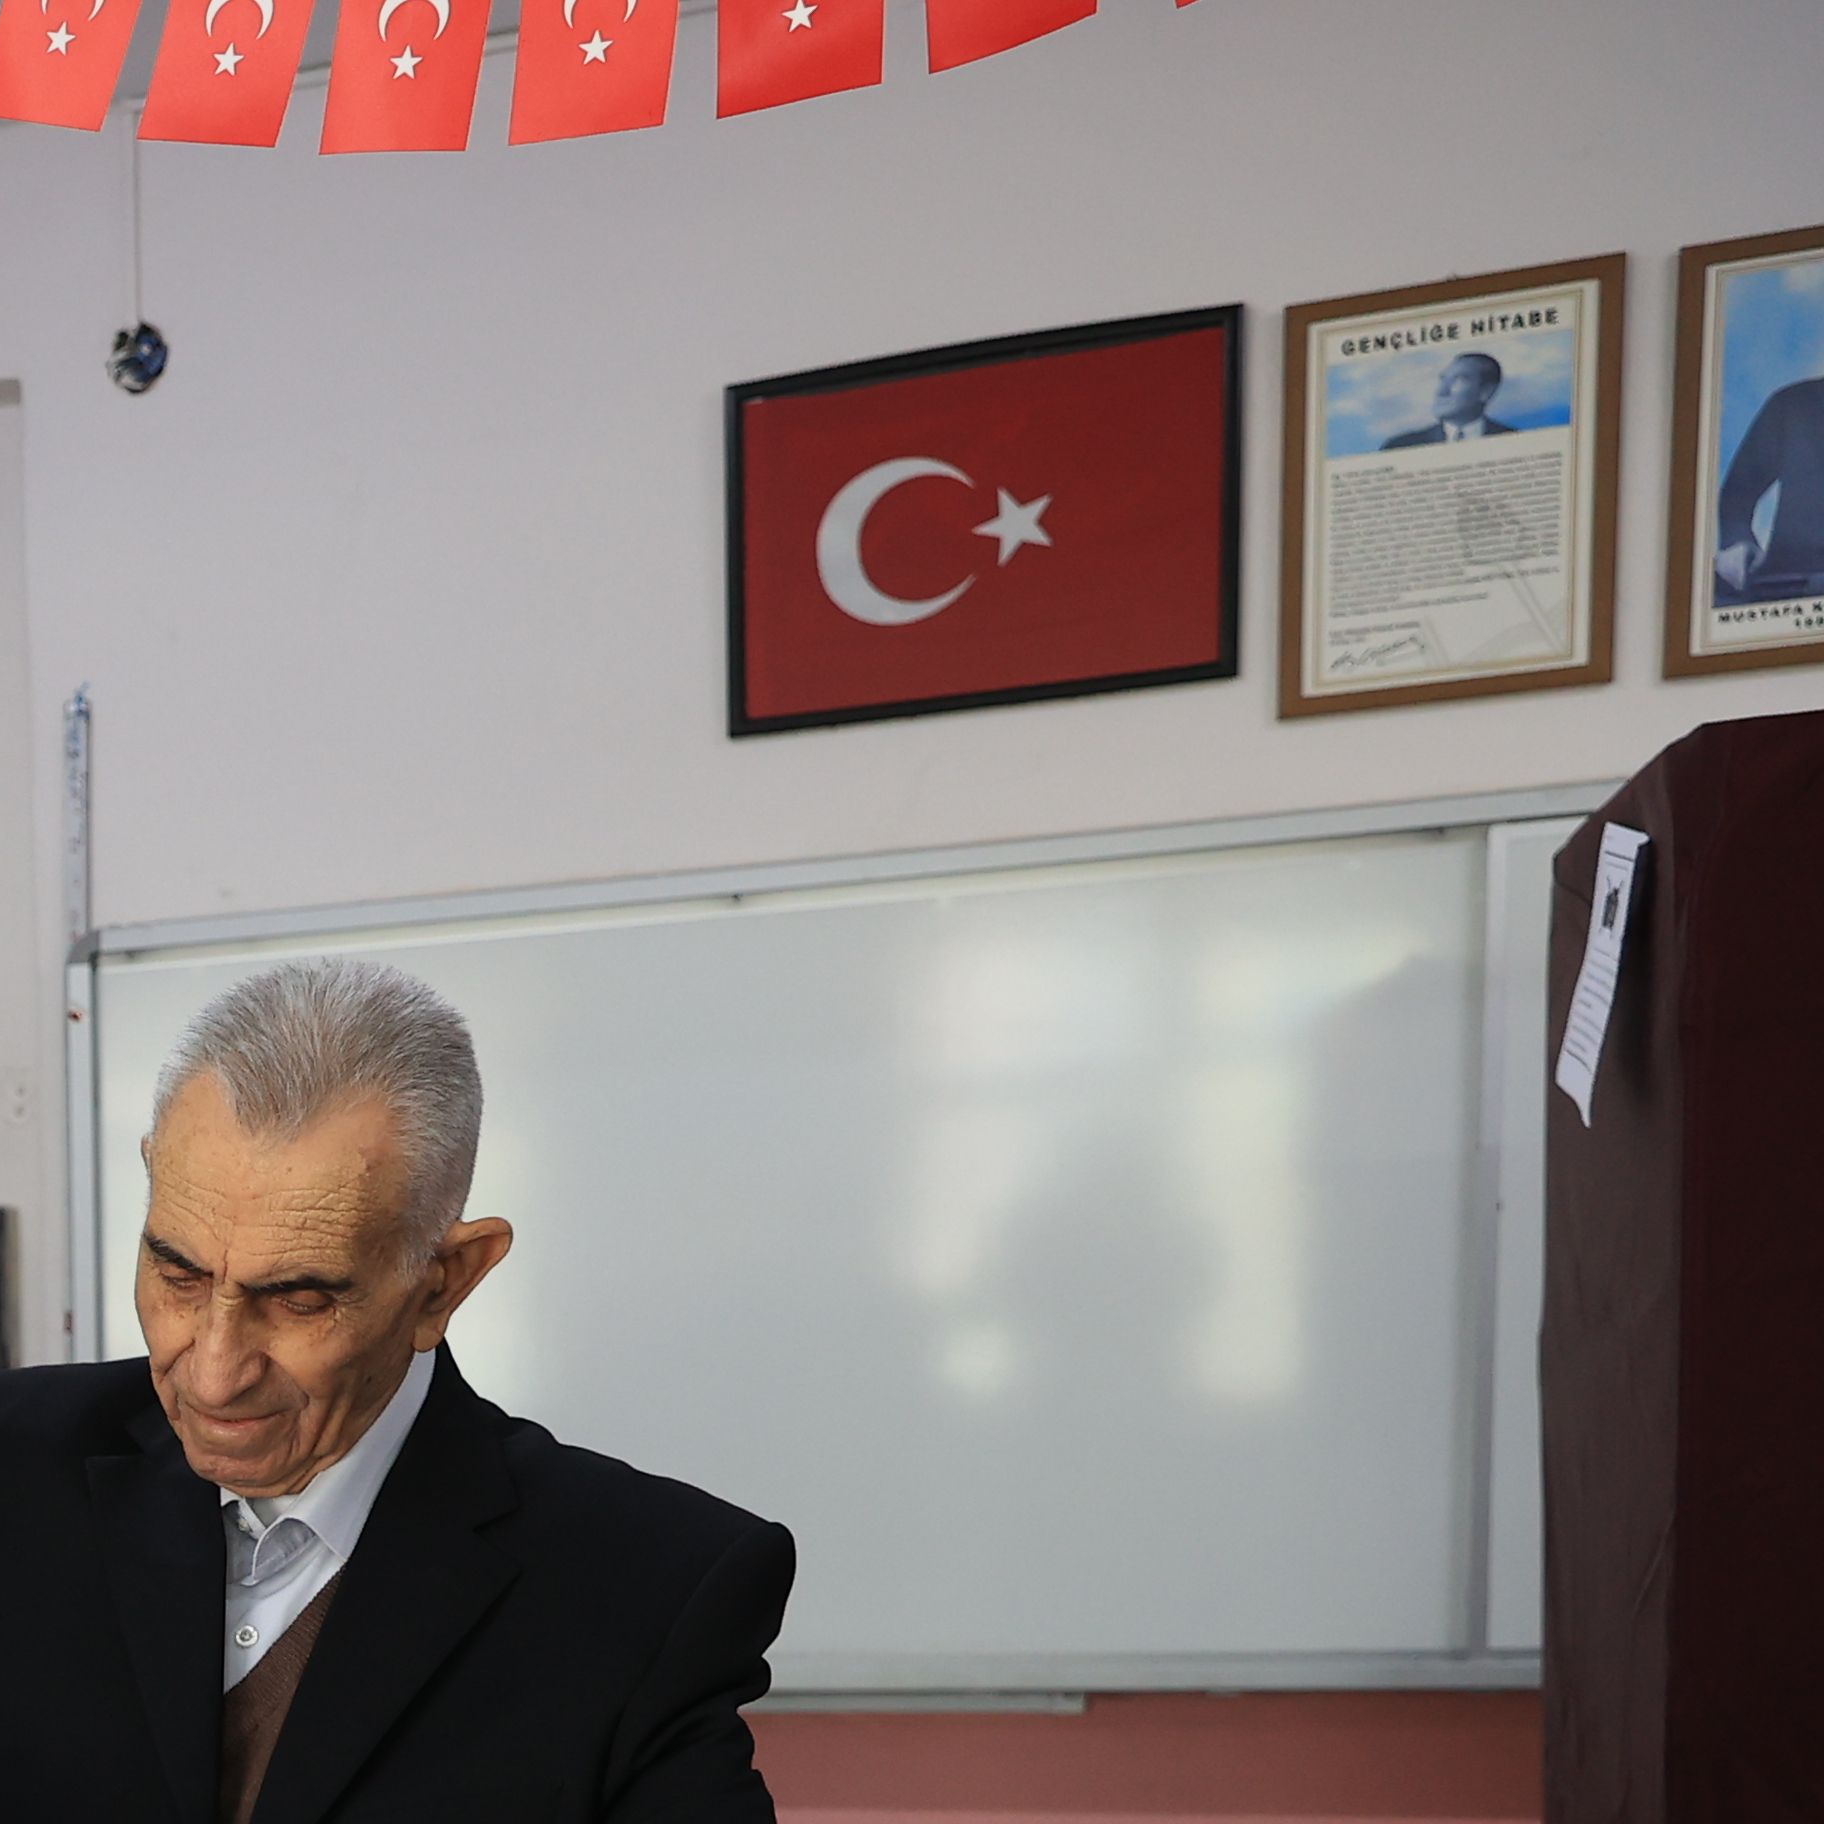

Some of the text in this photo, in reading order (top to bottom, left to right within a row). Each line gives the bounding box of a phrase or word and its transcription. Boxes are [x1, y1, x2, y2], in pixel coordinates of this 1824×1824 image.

[1341, 307, 1560, 356] GENÇLİĞE HİTABE
[1718, 604, 1803, 623] MUSTAFA
